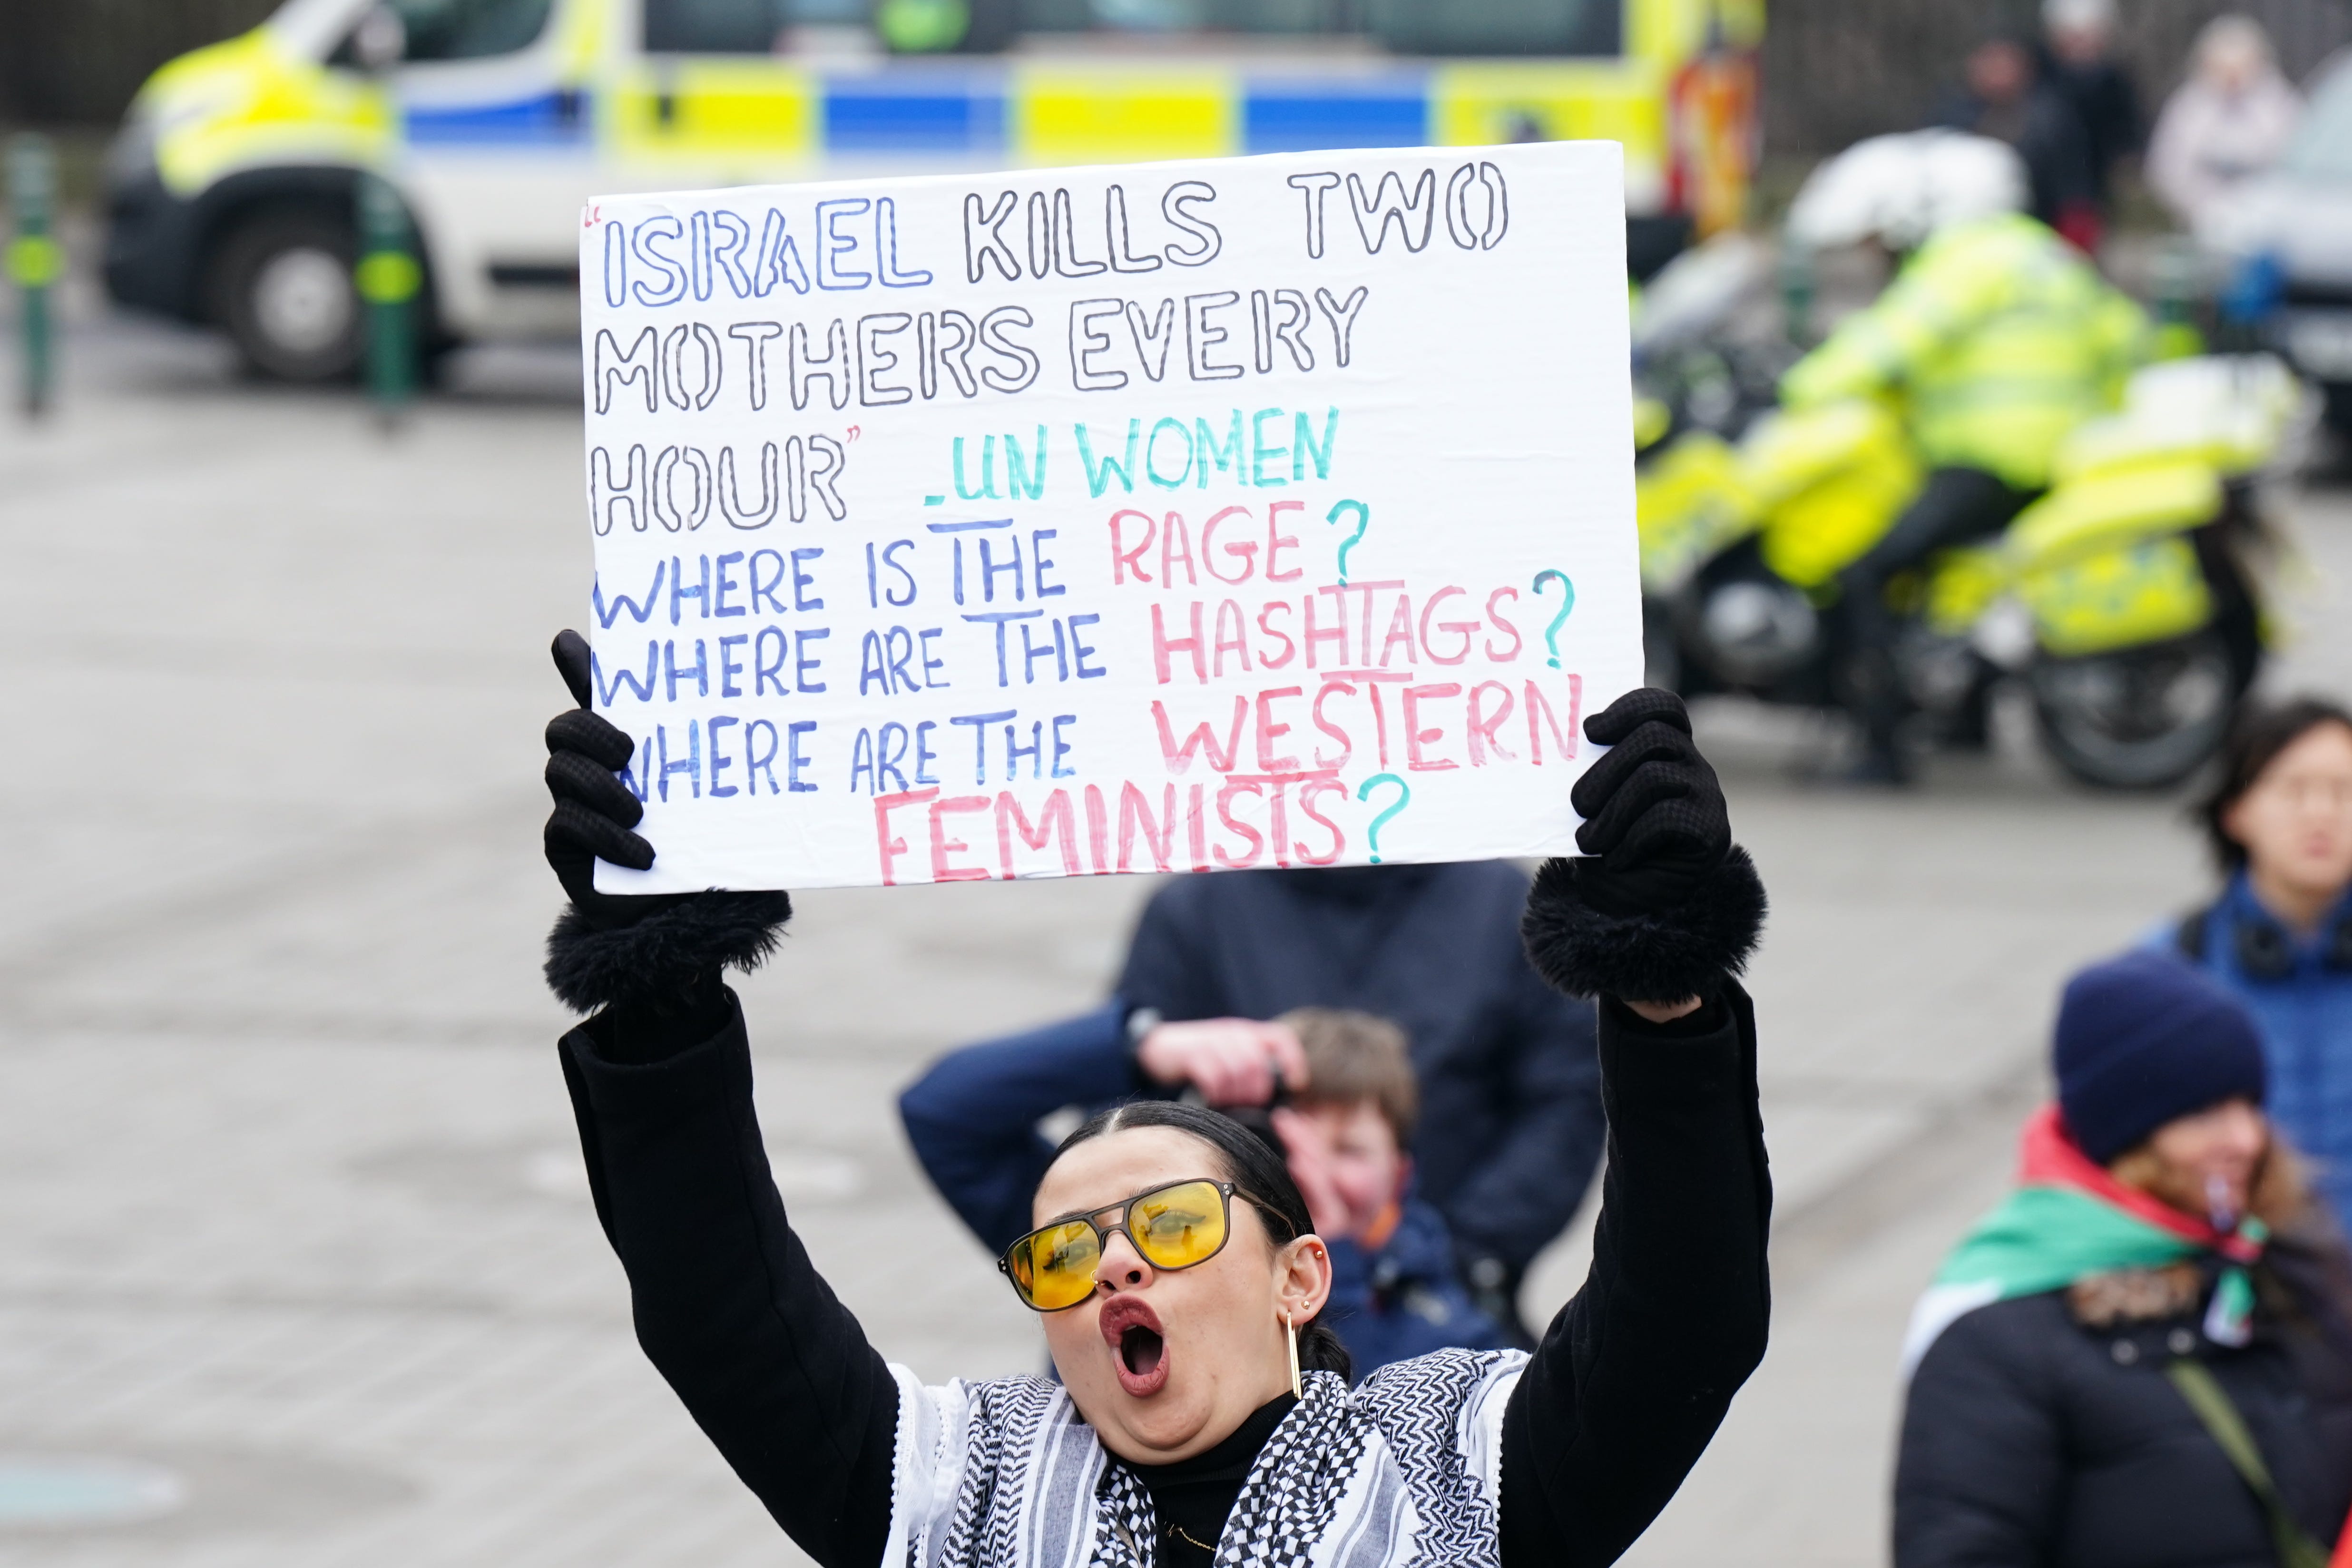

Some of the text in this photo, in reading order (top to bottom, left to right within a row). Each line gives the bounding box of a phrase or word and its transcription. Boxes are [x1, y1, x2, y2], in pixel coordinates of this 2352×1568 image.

[964, 181, 1222, 283] KILLS
[1287, 162, 1509, 259] TWO
[595, 286, 1369, 415] MOTHERS EVERY
[1075, 405, 1339, 498] WOMEN
[593, 548, 824, 629] WHERE
[866, 539, 916, 608] IS
[926, 519, 1066, 606] THE
[592, 569, 1575, 707] WHERE ARE THE HASHTAGS?
[851, 720, 940, 796] ARE
[951, 710, 1077, 786] THE
[1151, 669, 1582, 775] WESTERN
[874, 770, 1411, 886] FEMINISTS?
